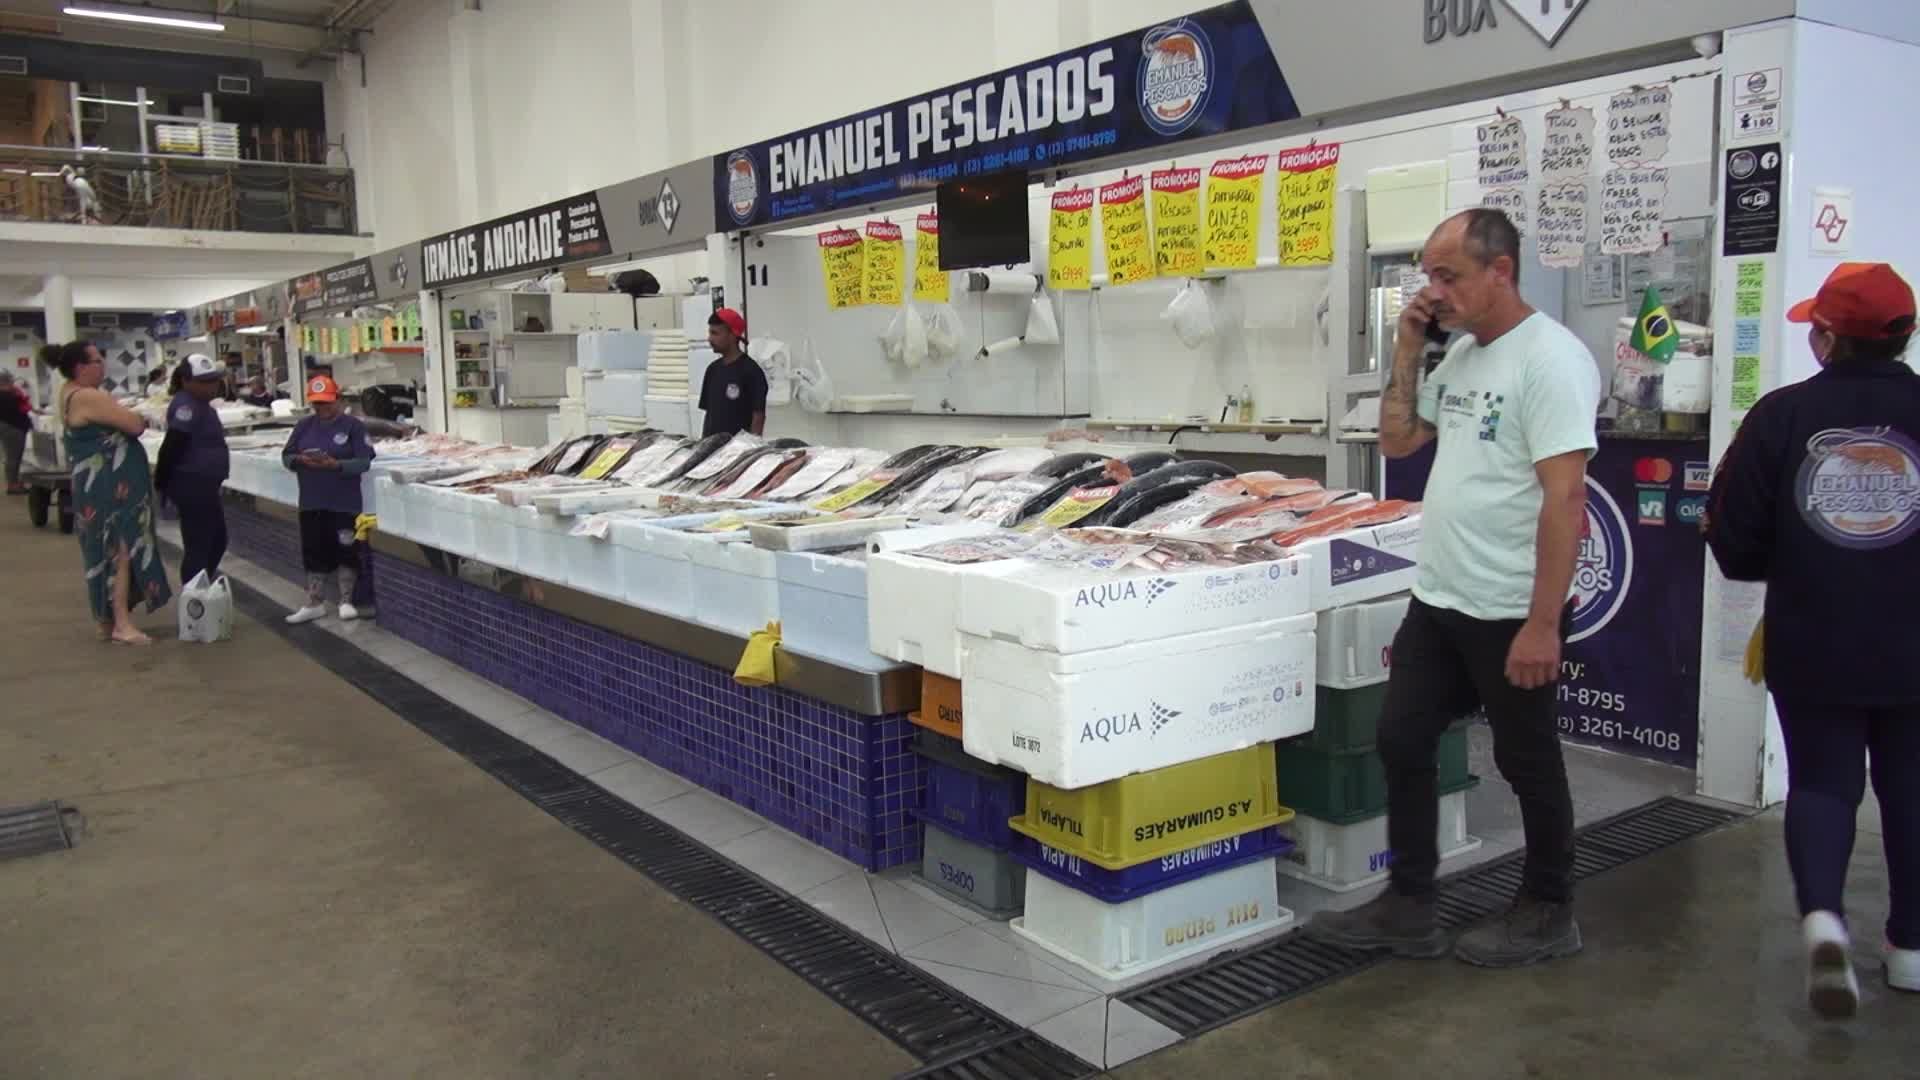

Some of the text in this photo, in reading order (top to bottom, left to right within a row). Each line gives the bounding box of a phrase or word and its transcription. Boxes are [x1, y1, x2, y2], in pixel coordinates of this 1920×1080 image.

[1424, 0, 1497, 44] BOX
[1147, 60, 1202, 87] EMANUEL
[1142, 77, 1208, 107] PESCADOS
[769, 46, 1116, 193] EMANUEL PESCADOS
[1211, 158, 1266, 176] PROMOÇÃO
[1280, 146, 1339, 169] PROMOÇÃO
[1102, 177, 1143, 202] PROMOÇÃO
[1152, 171, 1200, 189] PROMOÇÃO
[1052, 192, 1093, 208] PROMOÇÃO
[424, 210, 563, 284] IRMÃOS ANDRADE
[747, 263, 768, 286] 11
[1816, 474, 1912, 492] EMANUEL
[1075, 580, 1138, 608] AQUA
[1080, 712, 1142, 744] AQUA
[1579, 716, 1681, 751] 3261-4108
[1134, 799, 1252, 842] A.S GUIMARÃES
